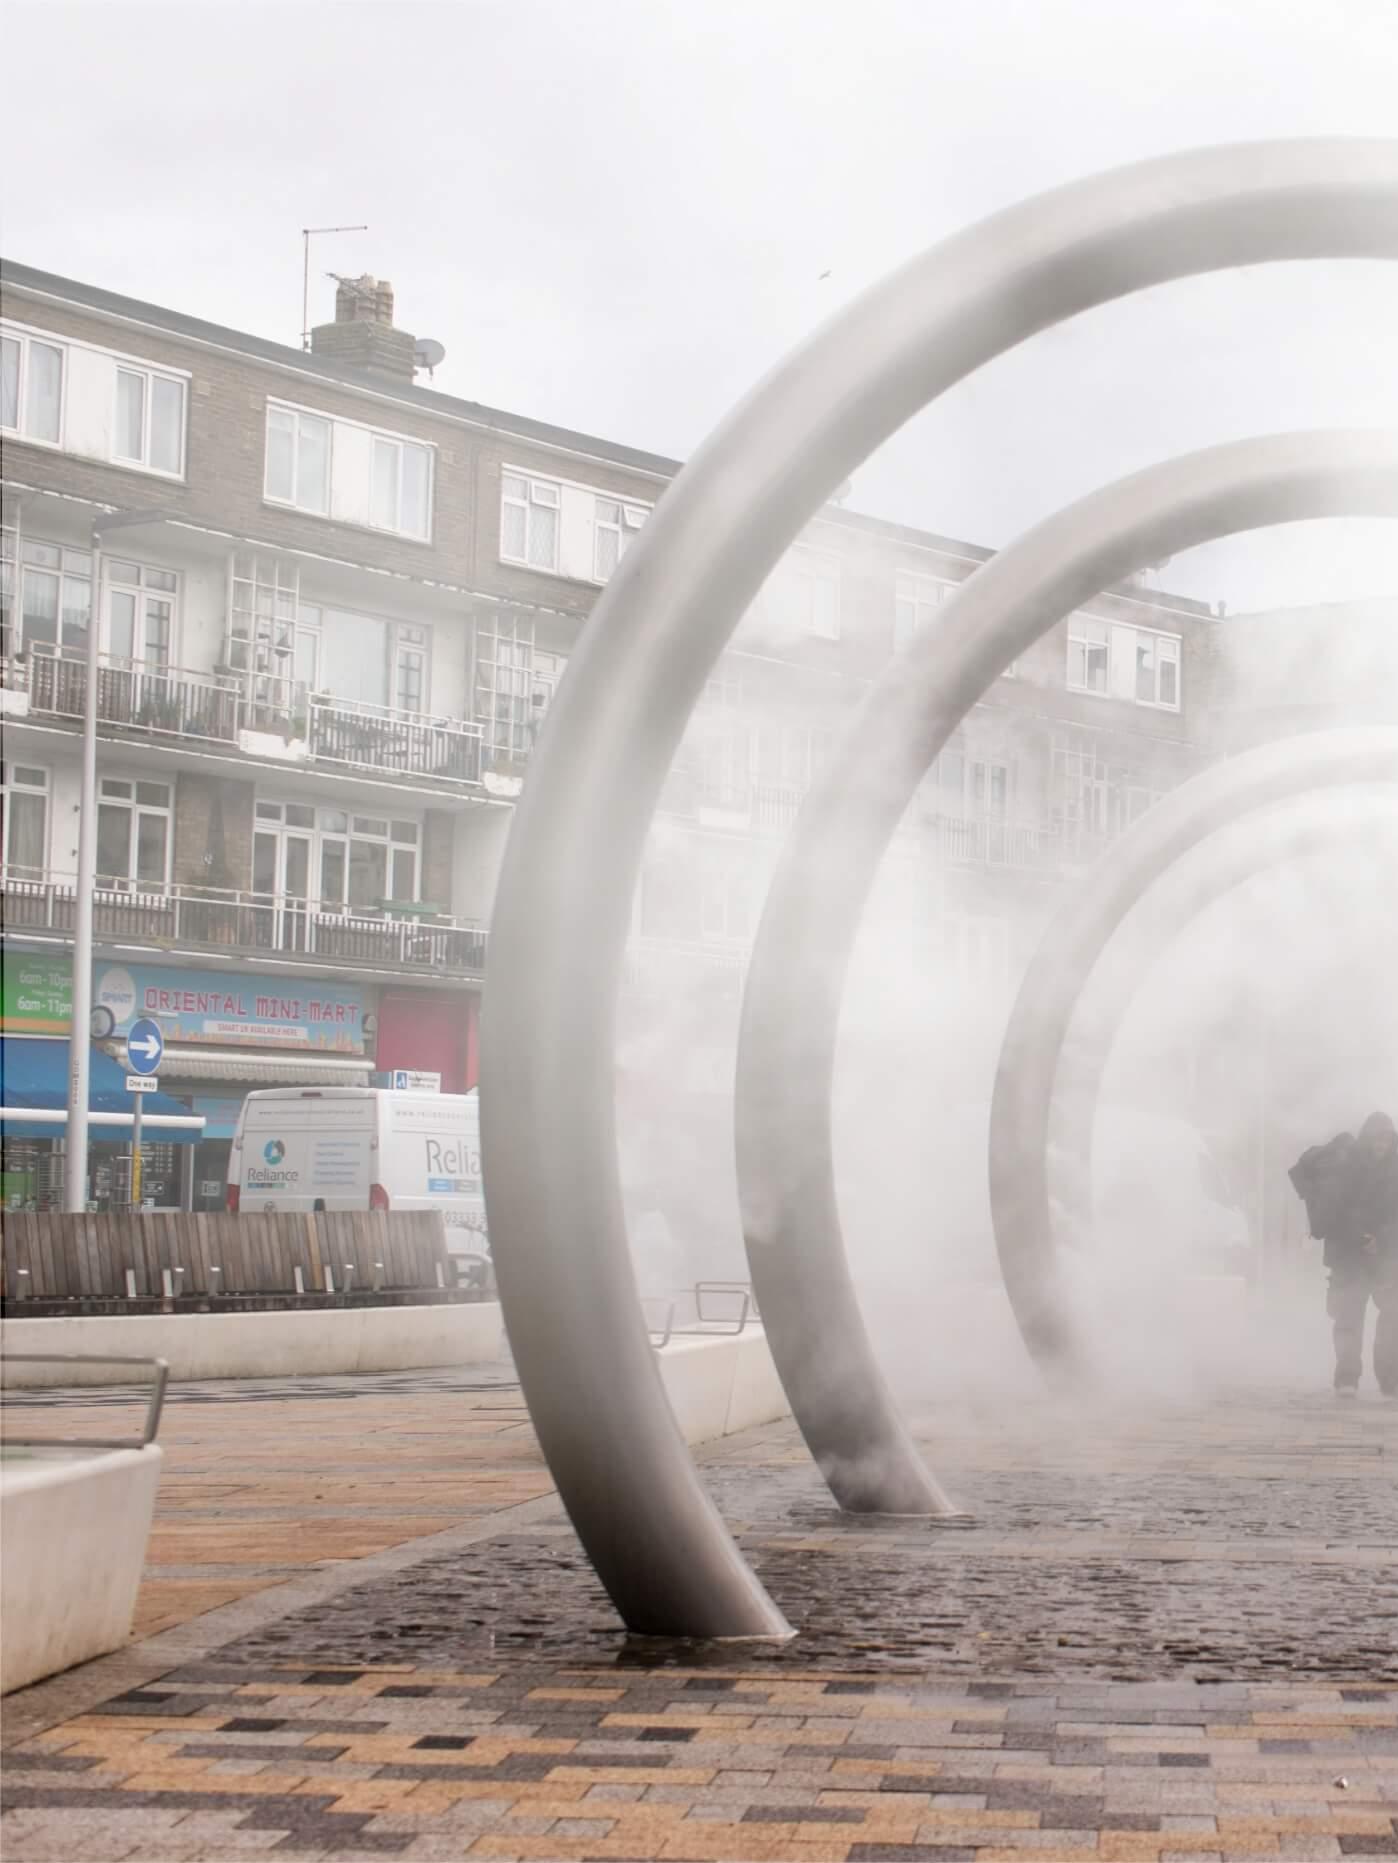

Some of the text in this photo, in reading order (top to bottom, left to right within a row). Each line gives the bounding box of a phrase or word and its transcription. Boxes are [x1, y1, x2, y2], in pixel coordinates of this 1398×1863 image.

[144, 988, 360, 1025] ORIENTAL MINI-MART
[143, 1082, 156, 1090] way
[247, 1168, 299, 1182] Reliance
